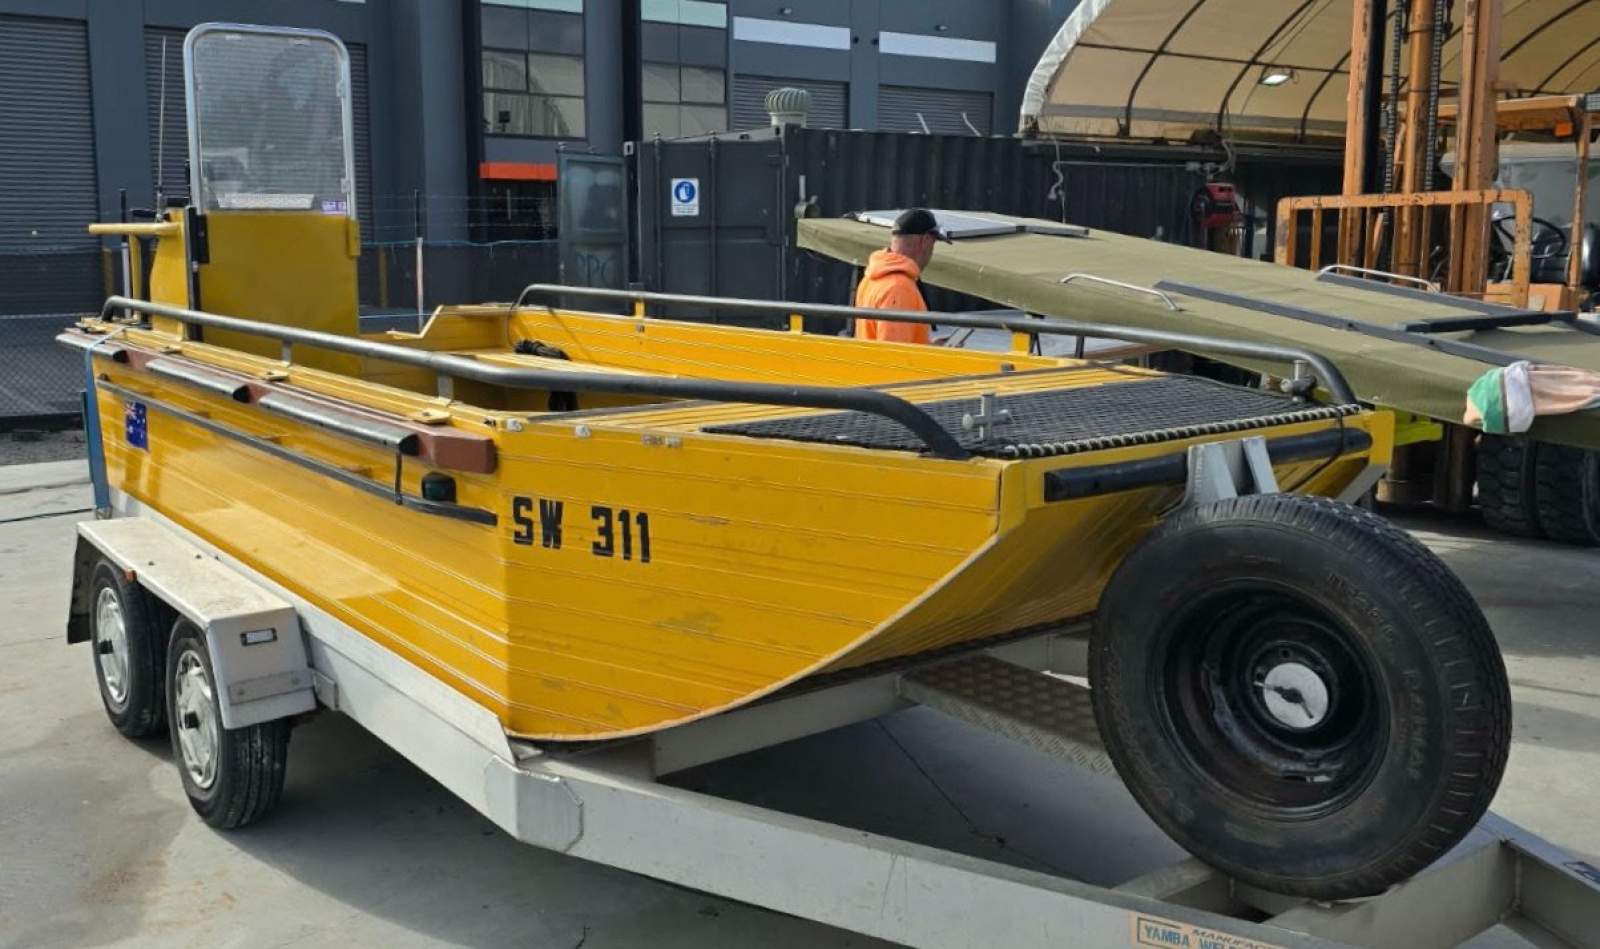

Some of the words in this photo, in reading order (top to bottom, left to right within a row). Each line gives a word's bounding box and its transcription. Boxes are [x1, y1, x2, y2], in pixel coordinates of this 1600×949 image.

[512, 496, 564, 549] SW
[591, 505, 650, 563] 311
[1144, 924, 1190, 948] YAMBA
